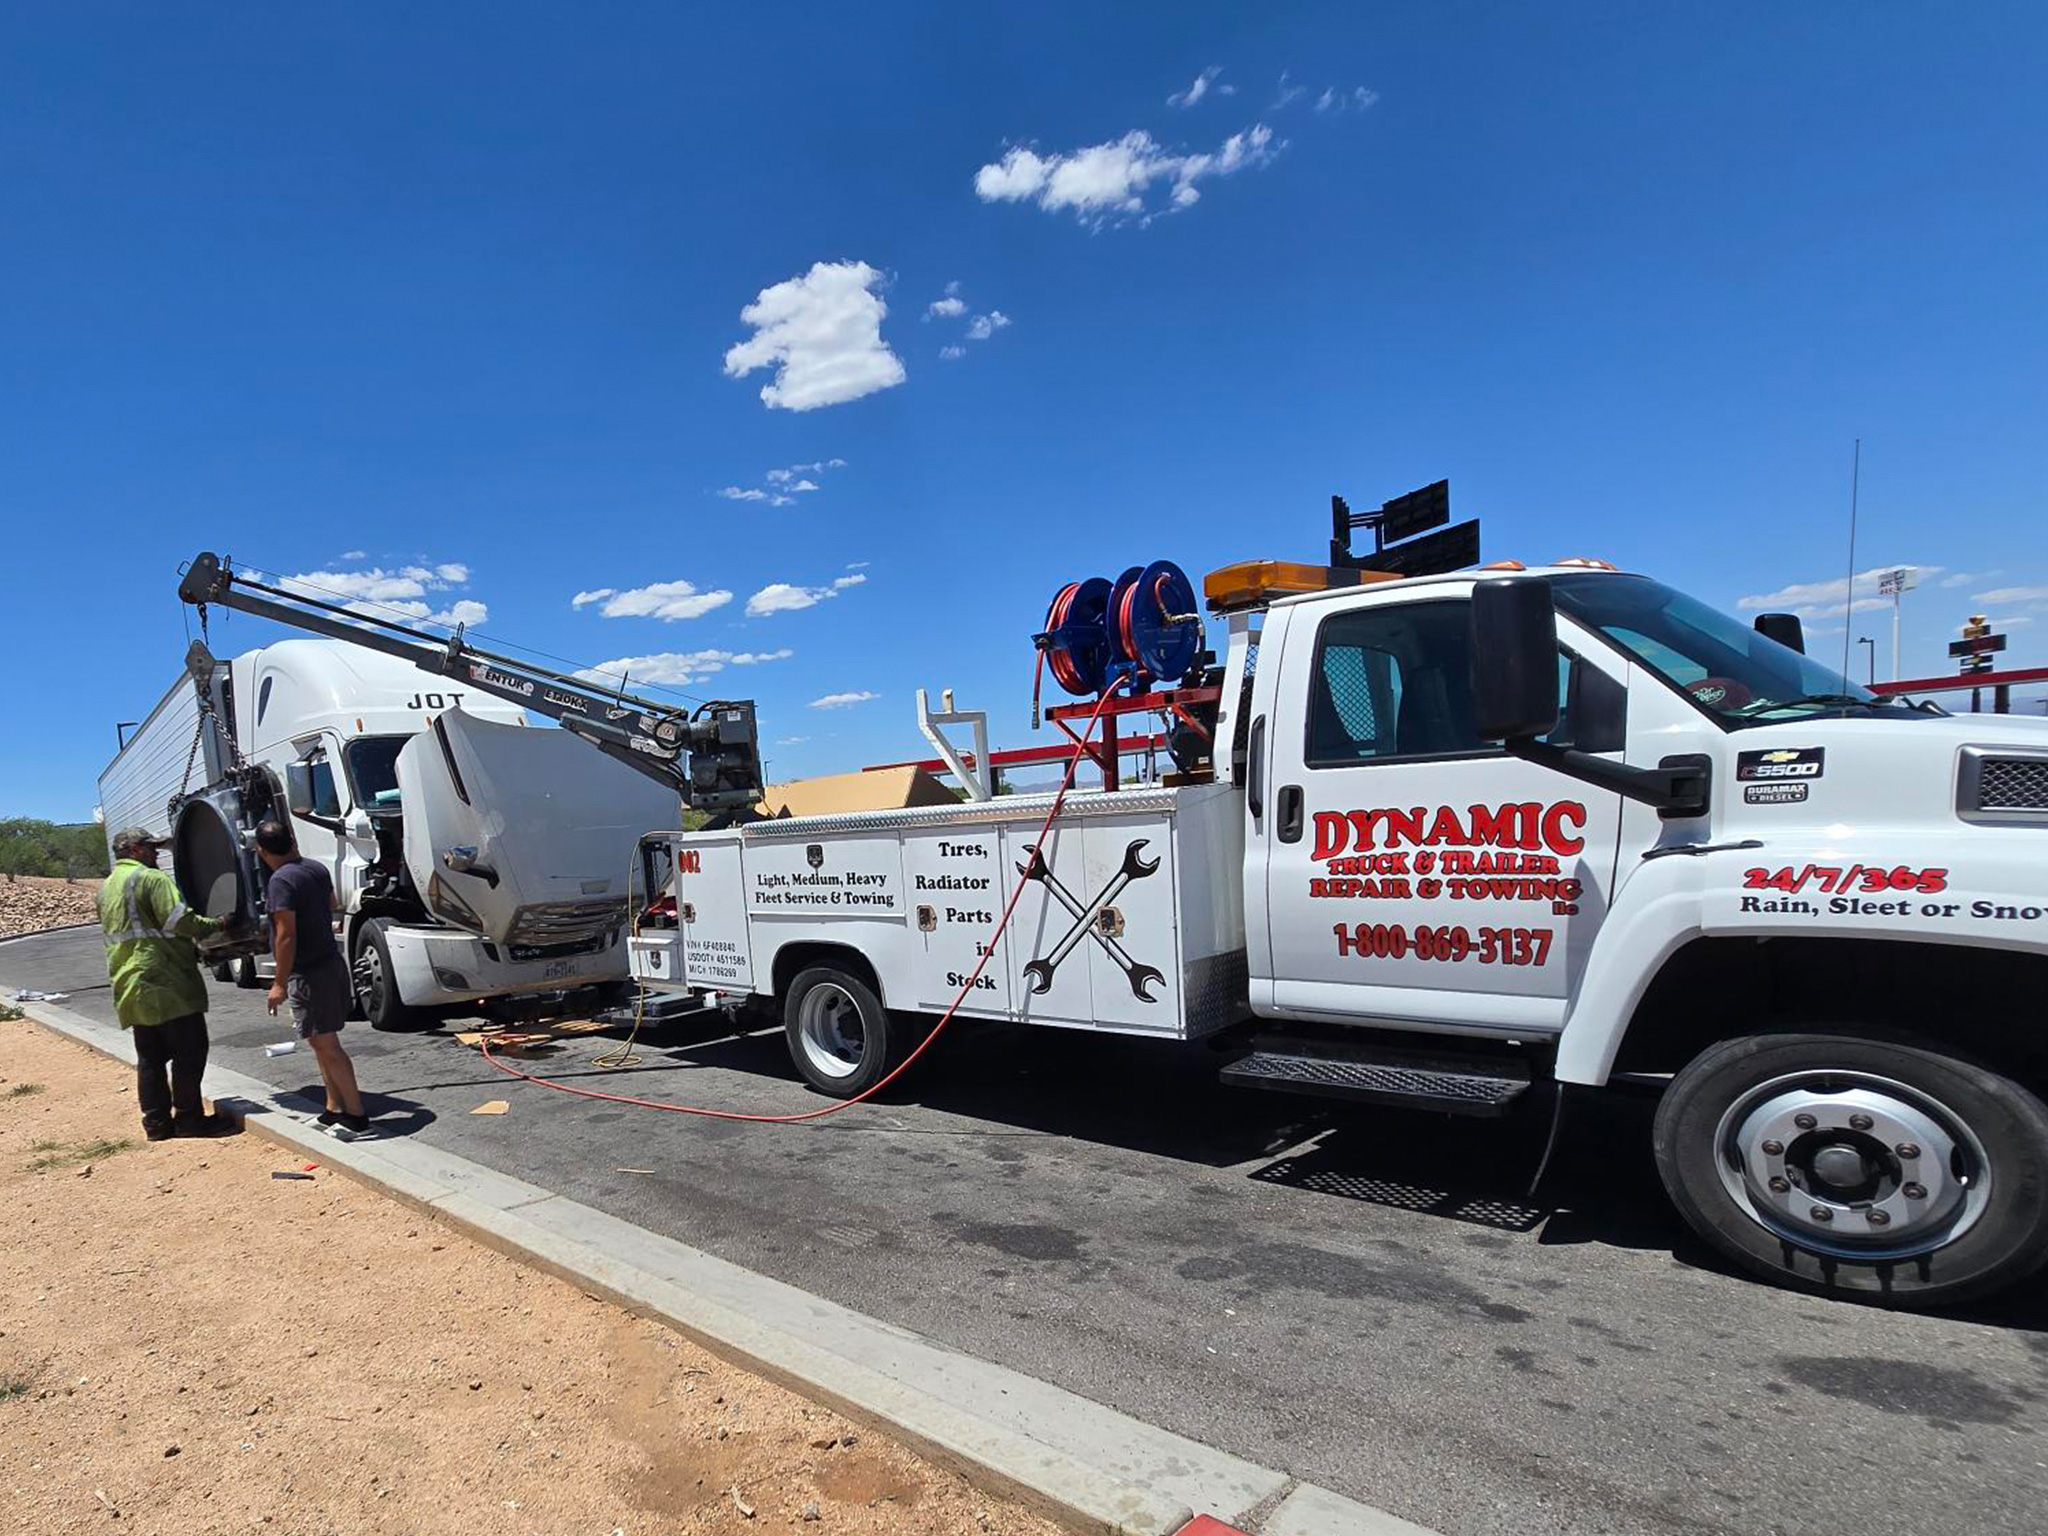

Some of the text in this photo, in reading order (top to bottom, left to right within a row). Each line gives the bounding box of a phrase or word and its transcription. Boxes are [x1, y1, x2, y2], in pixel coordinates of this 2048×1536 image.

[407, 693, 465, 710] JOT
[1747, 784, 1807, 795] DURAMAX
[1760, 793, 1792, 801] DIESEL
[1311, 800, 1587, 861] DYNAMIC
[938, 842, 988, 859] Tires,
[1327, 851, 1561, 875] TRUCK & TRAILER
[757, 872, 887, 889] Light, Medium, Heavy
[915, 875, 990, 890] Radiator
[1742, 864, 1949, 895] 24/7/365
[1309, 878, 1583, 901] REPAIR & TOWING
[755, 891, 894, 908] Fleet Service & Towing
[1740, 896, 2048, 920] Rain, Sleet or Sno
[945, 908, 993, 924] Parts
[976, 942, 994, 957] in
[1333, 923, 1554, 967] 1-800-869-3137
[946, 972, 997, 990] Stock
